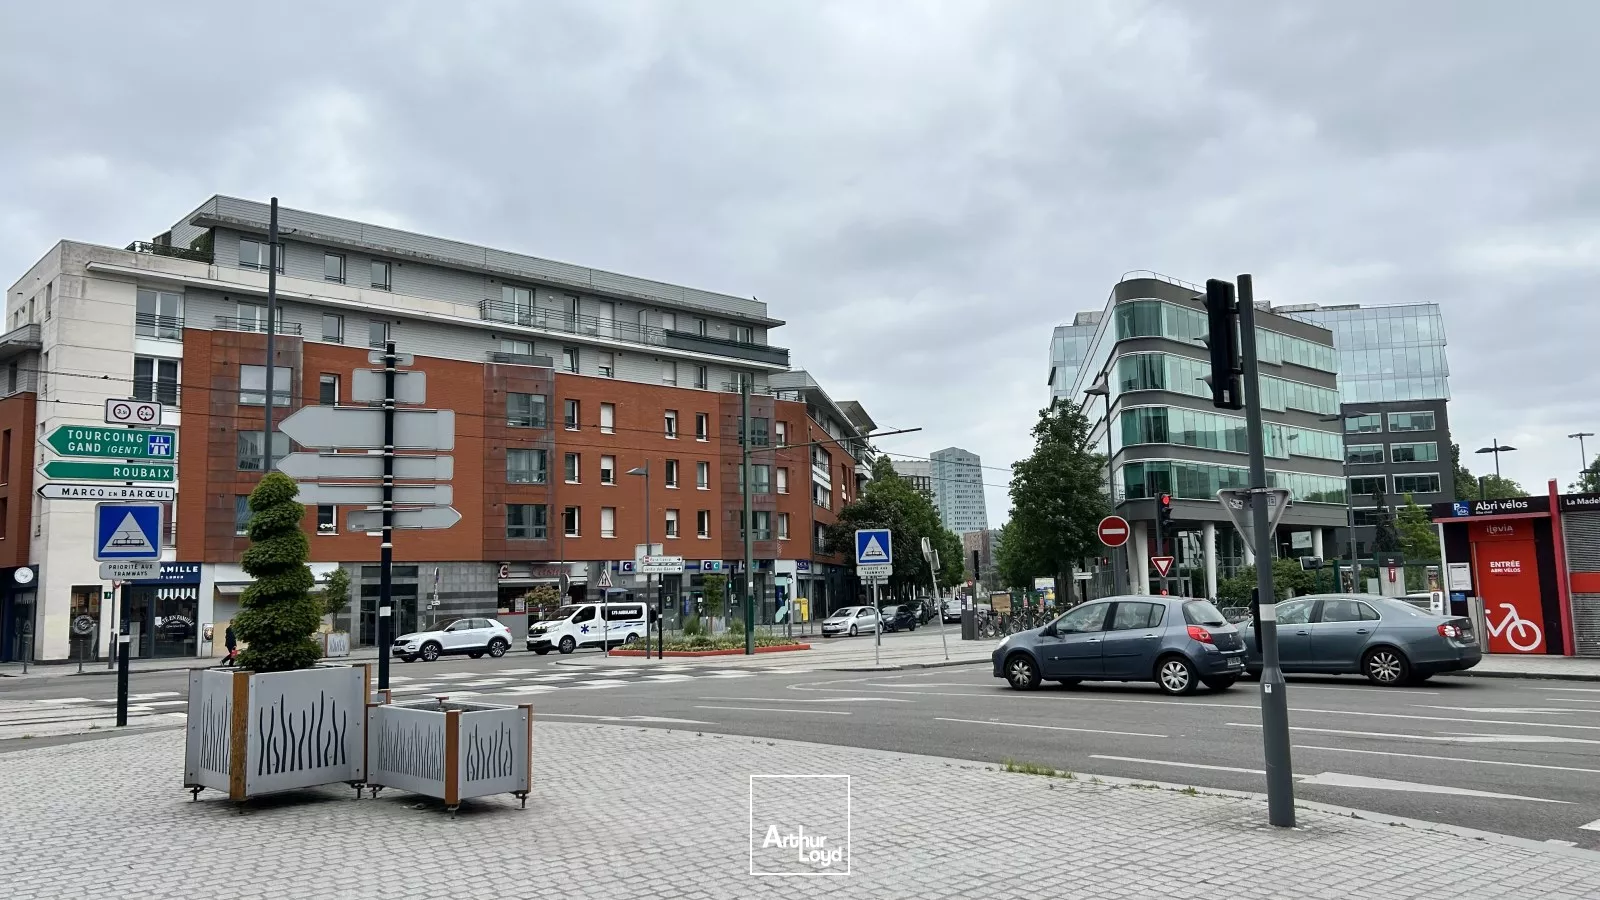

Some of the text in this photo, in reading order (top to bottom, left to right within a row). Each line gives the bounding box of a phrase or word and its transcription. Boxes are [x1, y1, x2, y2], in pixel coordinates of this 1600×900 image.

[67, 429, 143, 443] TOURCOING
[68, 442, 142, 455] GAND (GENT)
[113, 467, 170, 478] ROUBAIX
[1453, 502, 1460, 511] P
[1475, 499, 1528, 511] Abri vélos
[1566, 498, 1576, 506] La
[1489, 559, 1521, 568] ENTRÉE
